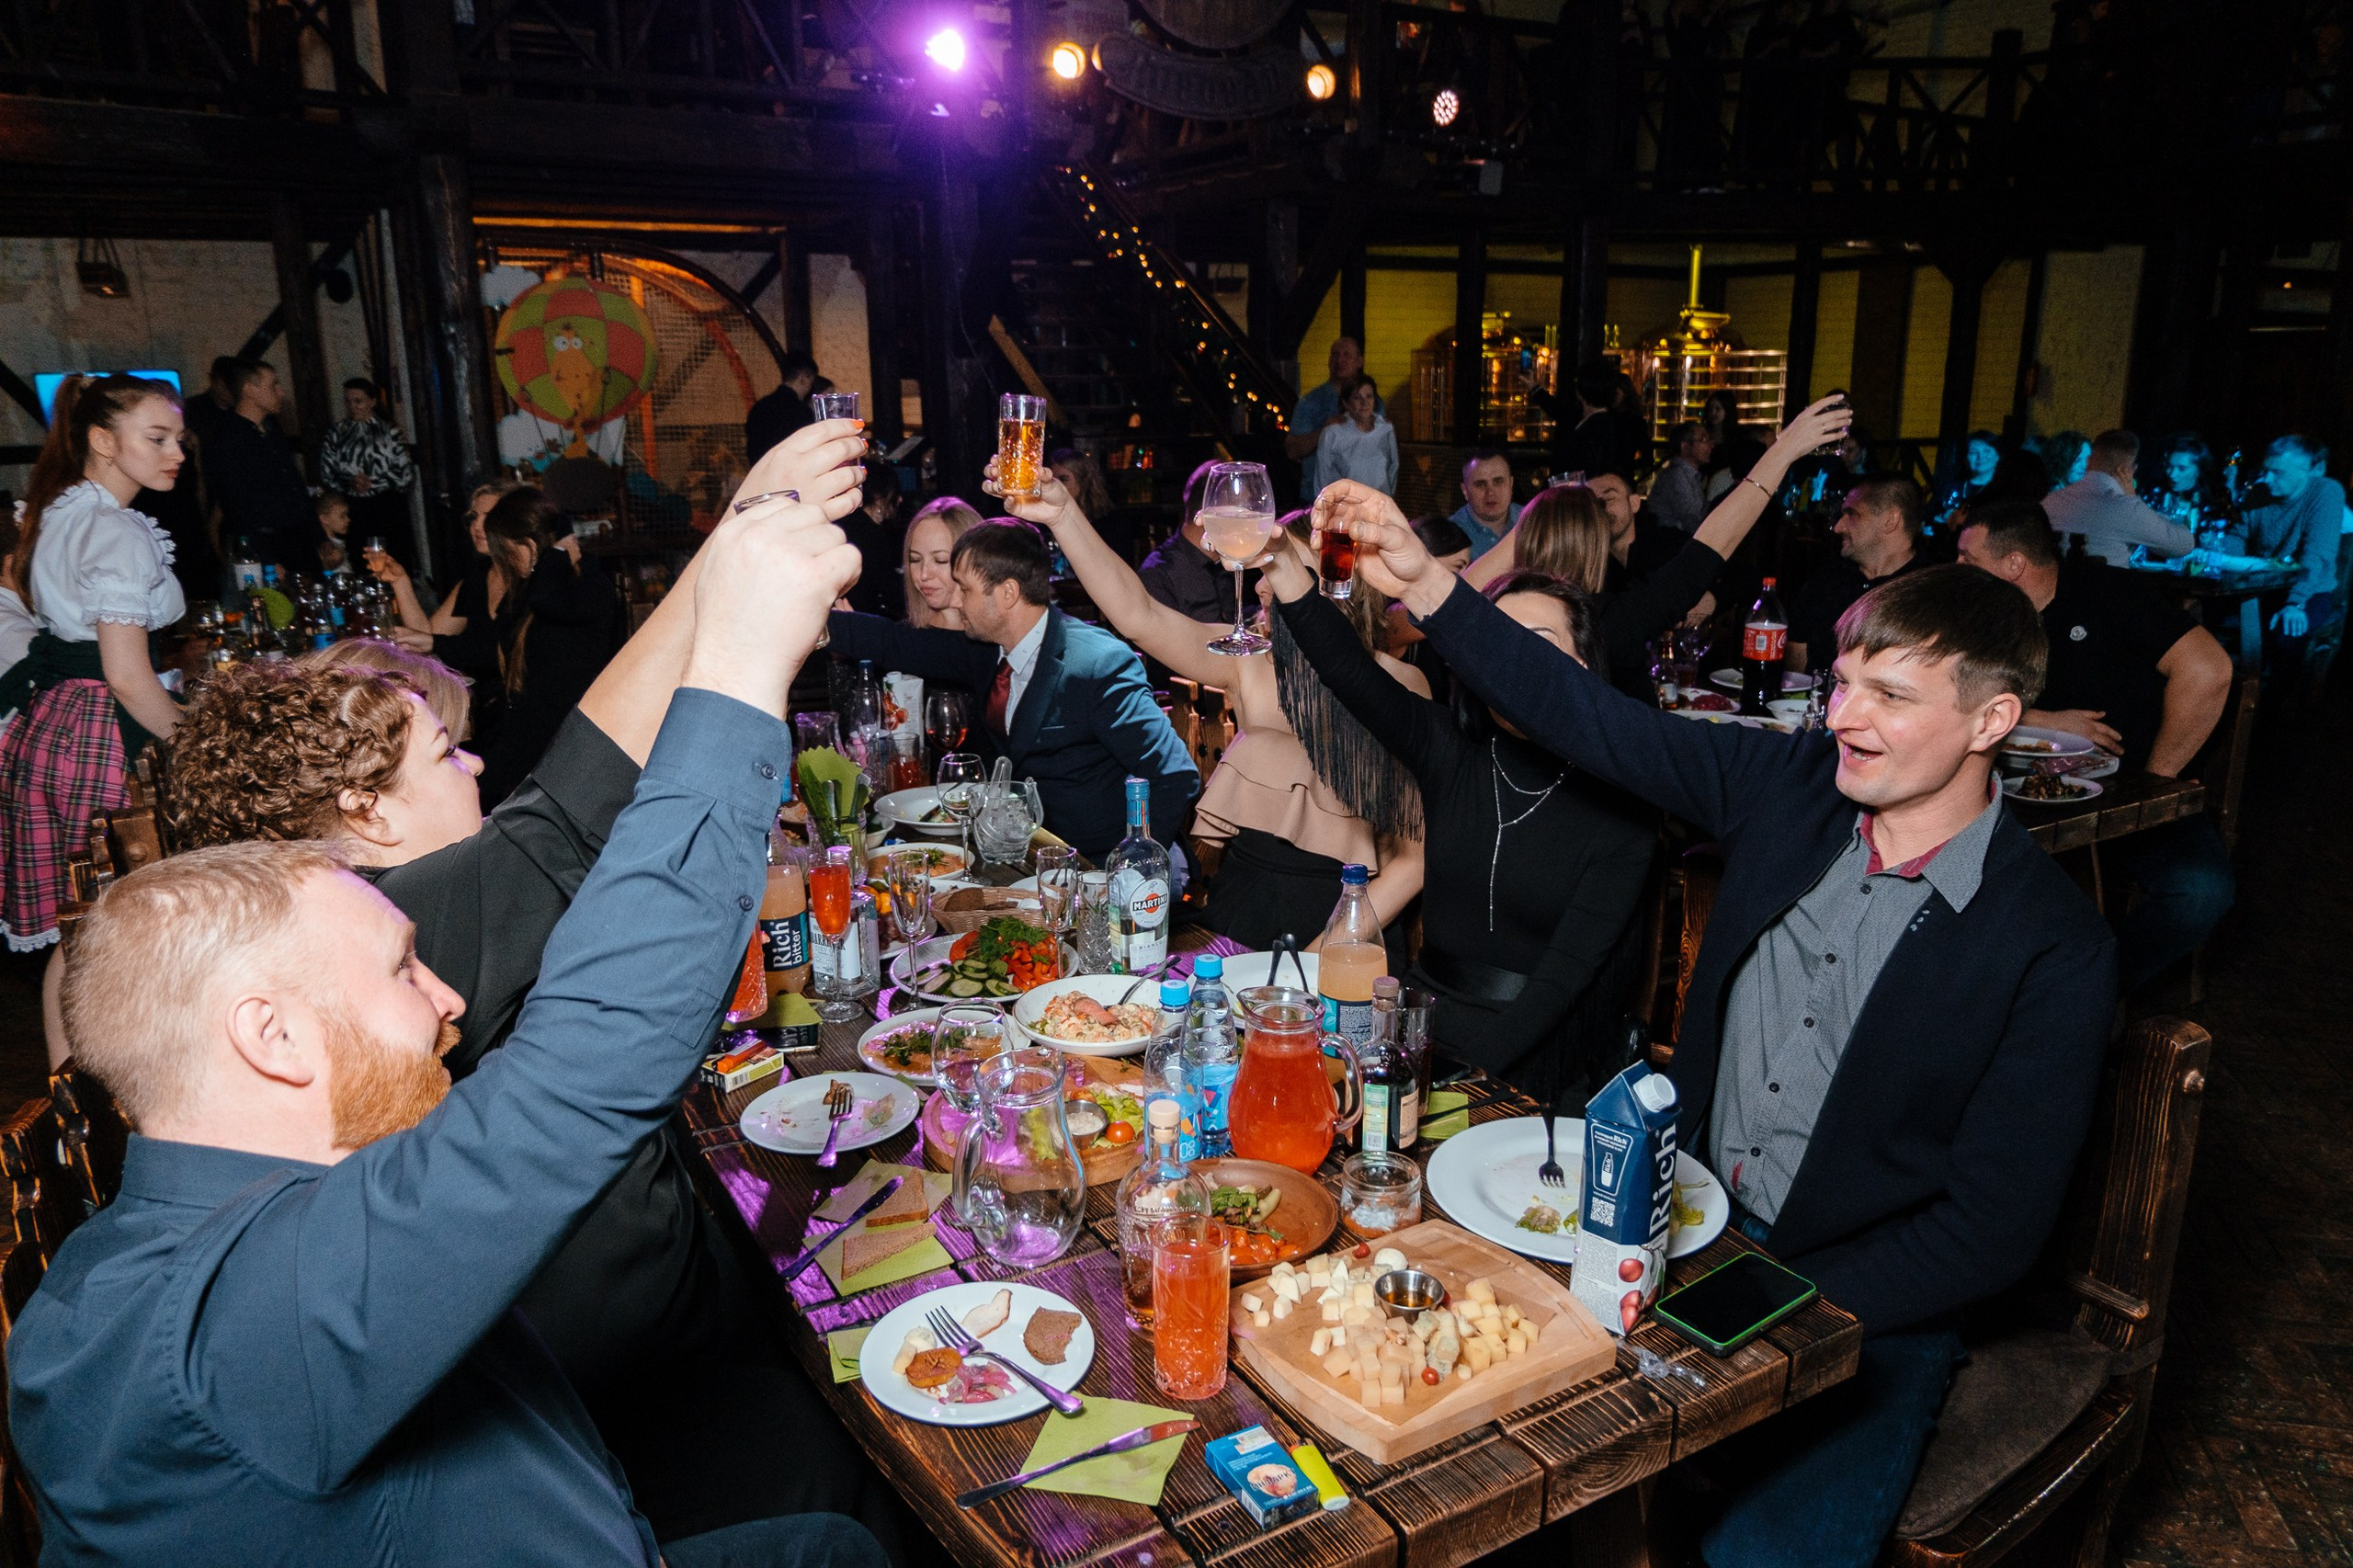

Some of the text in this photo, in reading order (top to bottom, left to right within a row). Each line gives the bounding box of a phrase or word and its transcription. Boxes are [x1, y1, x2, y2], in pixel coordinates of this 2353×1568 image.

[1133, 893, 1167, 911] MARTINI
[771, 920, 792, 968] Rich
[791, 930, 802, 965] bitter
[1139, 939, 1163, 950] BIANCO
[1649, 1121, 1677, 1238] Rich
[1249, 1467, 1296, 1491] ИНФАРКТ
